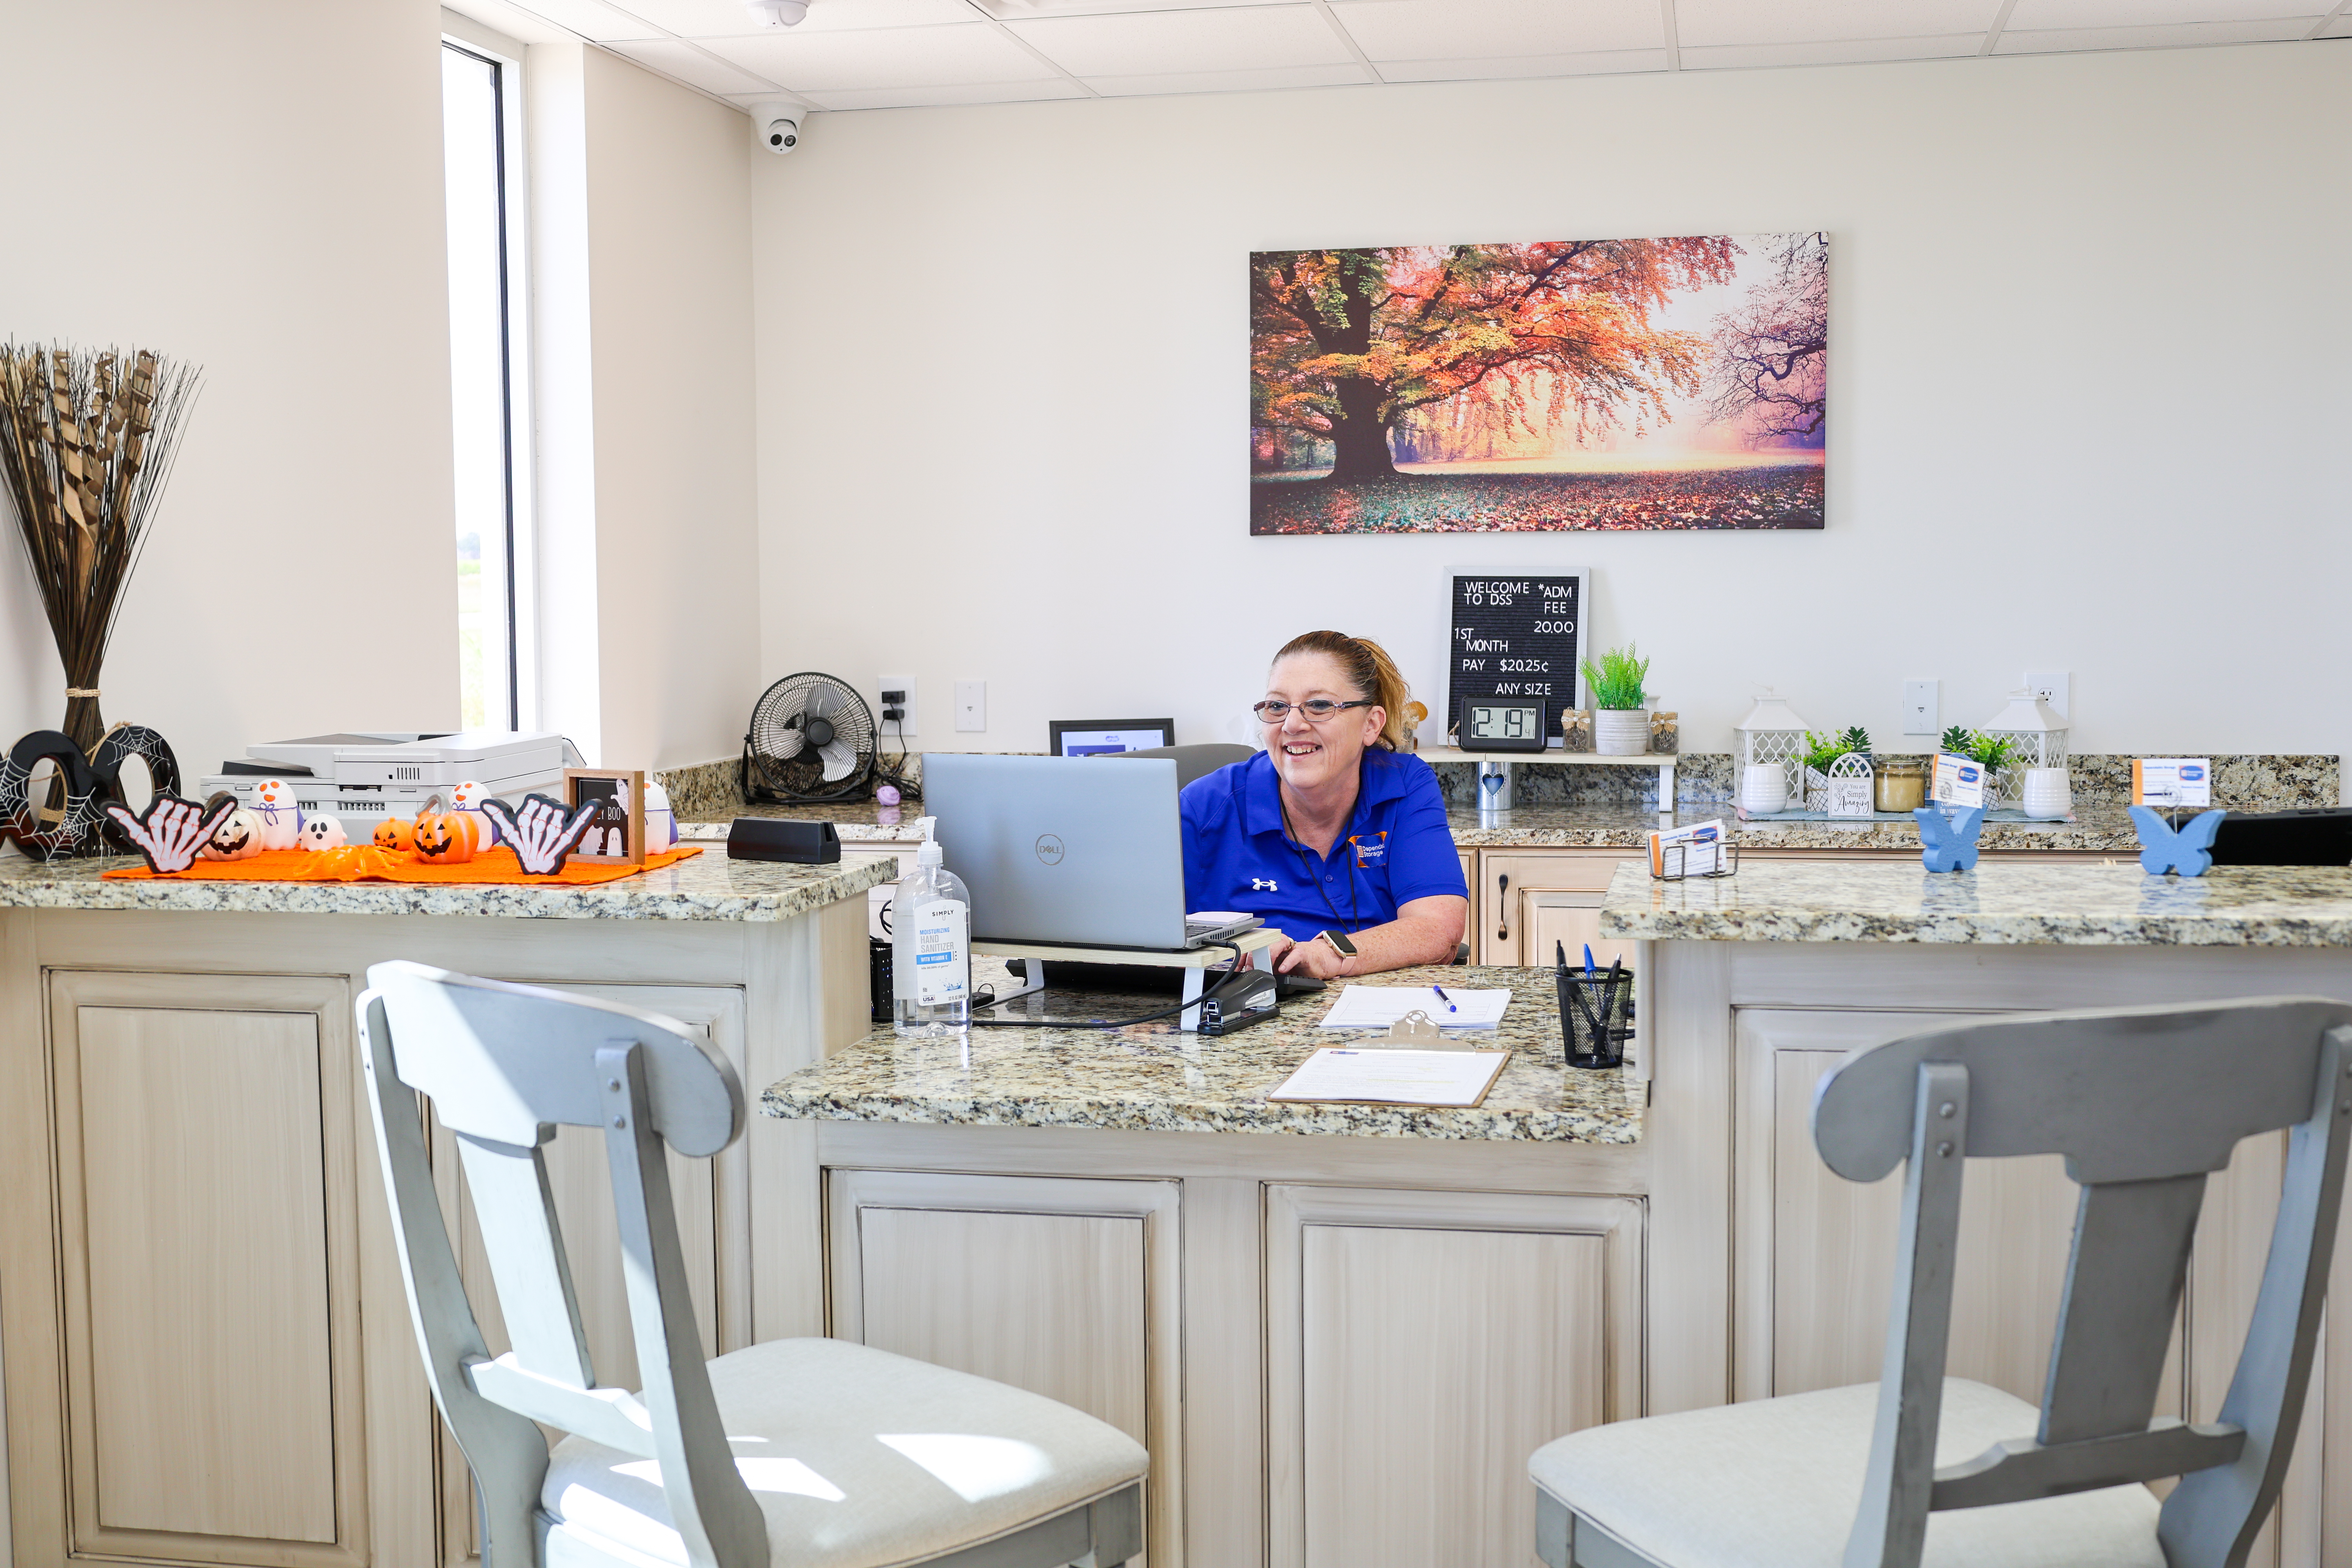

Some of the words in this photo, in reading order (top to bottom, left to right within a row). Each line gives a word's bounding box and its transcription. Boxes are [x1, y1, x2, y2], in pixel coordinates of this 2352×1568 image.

[1465, 582, 1529, 594] WELCOME
[1464, 593, 1482, 605] TO
[1490, 593, 1512, 605] DSS
[1544, 602, 1566, 614] FEE
[1534, 621, 1574, 633] 20.00
[1454, 628, 1474, 640] 1ST
[1466, 639, 1508, 652] MONTH
[1463, 659, 1485, 671] PAY
[1495, 683, 1520, 695] ANY
[1524, 683, 1551, 695] SIZE
[1472, 709, 1523, 737] 12:19
[1847, 791, 1867, 799] Simply
[1835, 796, 1869, 814] Amazing
[608, 806, 621, 820] BOO
[920, 935, 939, 944] HAND
[921, 942, 954, 953] SANITIZER
